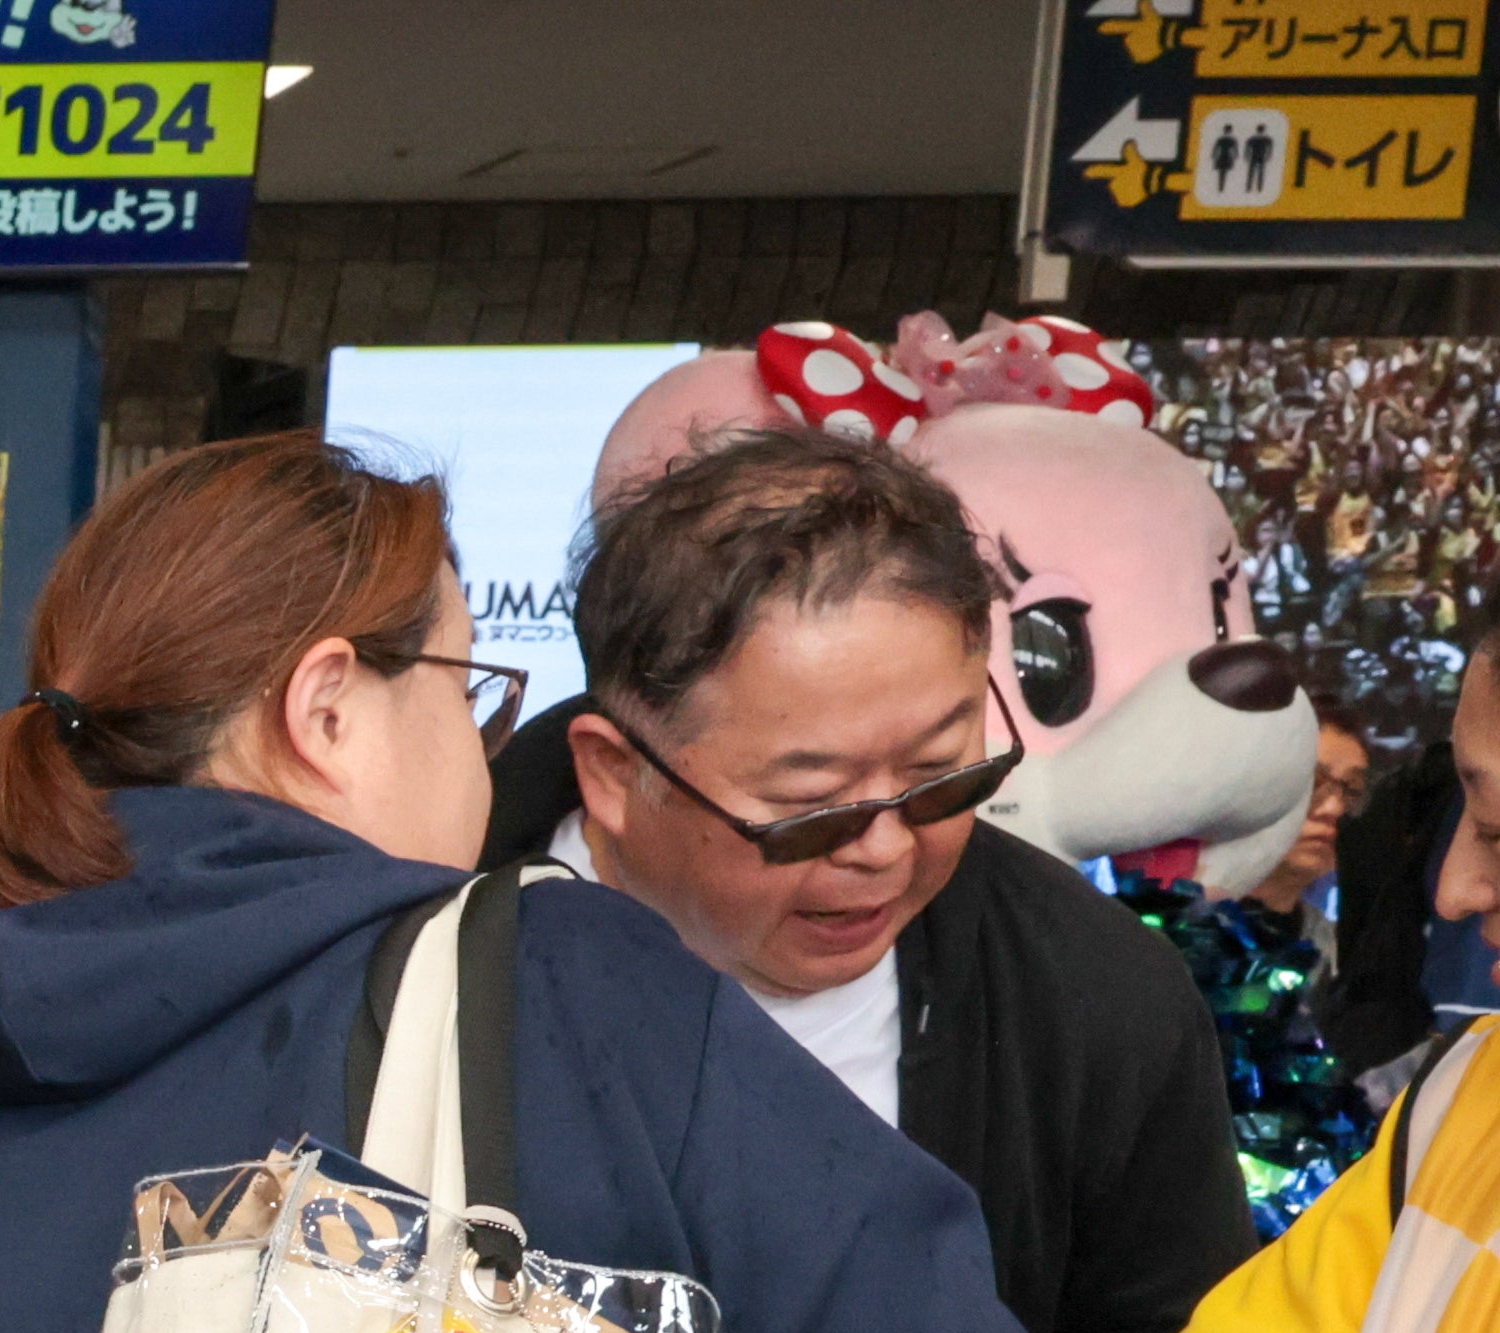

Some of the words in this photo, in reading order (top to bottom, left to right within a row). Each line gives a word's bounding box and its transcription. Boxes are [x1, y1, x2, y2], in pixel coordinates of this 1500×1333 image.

[1219, 17, 1468, 60] アリーナ入口
[1294, 128, 1456, 188] トイレ
